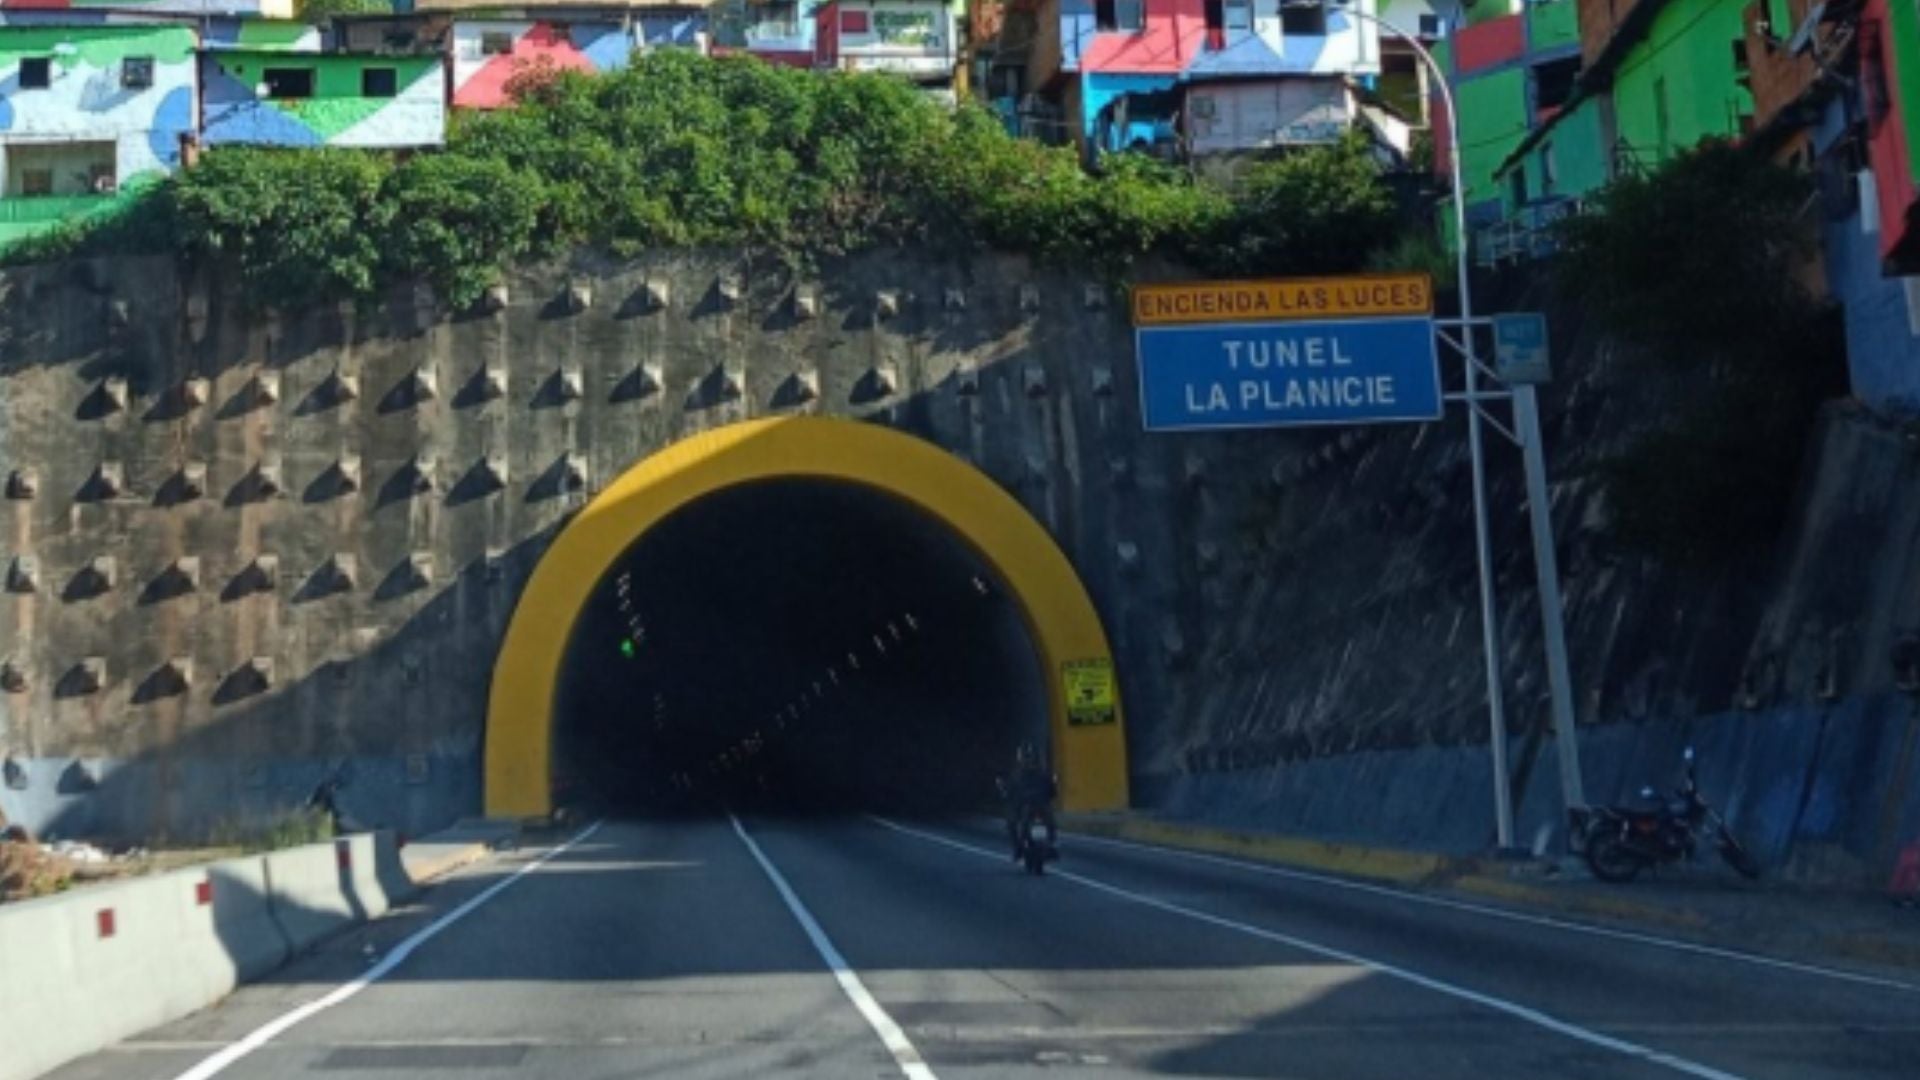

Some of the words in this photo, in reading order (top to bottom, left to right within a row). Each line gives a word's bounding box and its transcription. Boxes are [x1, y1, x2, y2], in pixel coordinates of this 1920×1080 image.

[1139, 292, 1270, 316] ENCIENDA
[1279, 287, 1328, 310] LAS
[1339, 283, 1424, 309] LUCES
[1223, 337, 1352, 369] TUNEL
[1186, 383, 1229, 411] LA
[1240, 375, 1395, 410] PLANICIE
